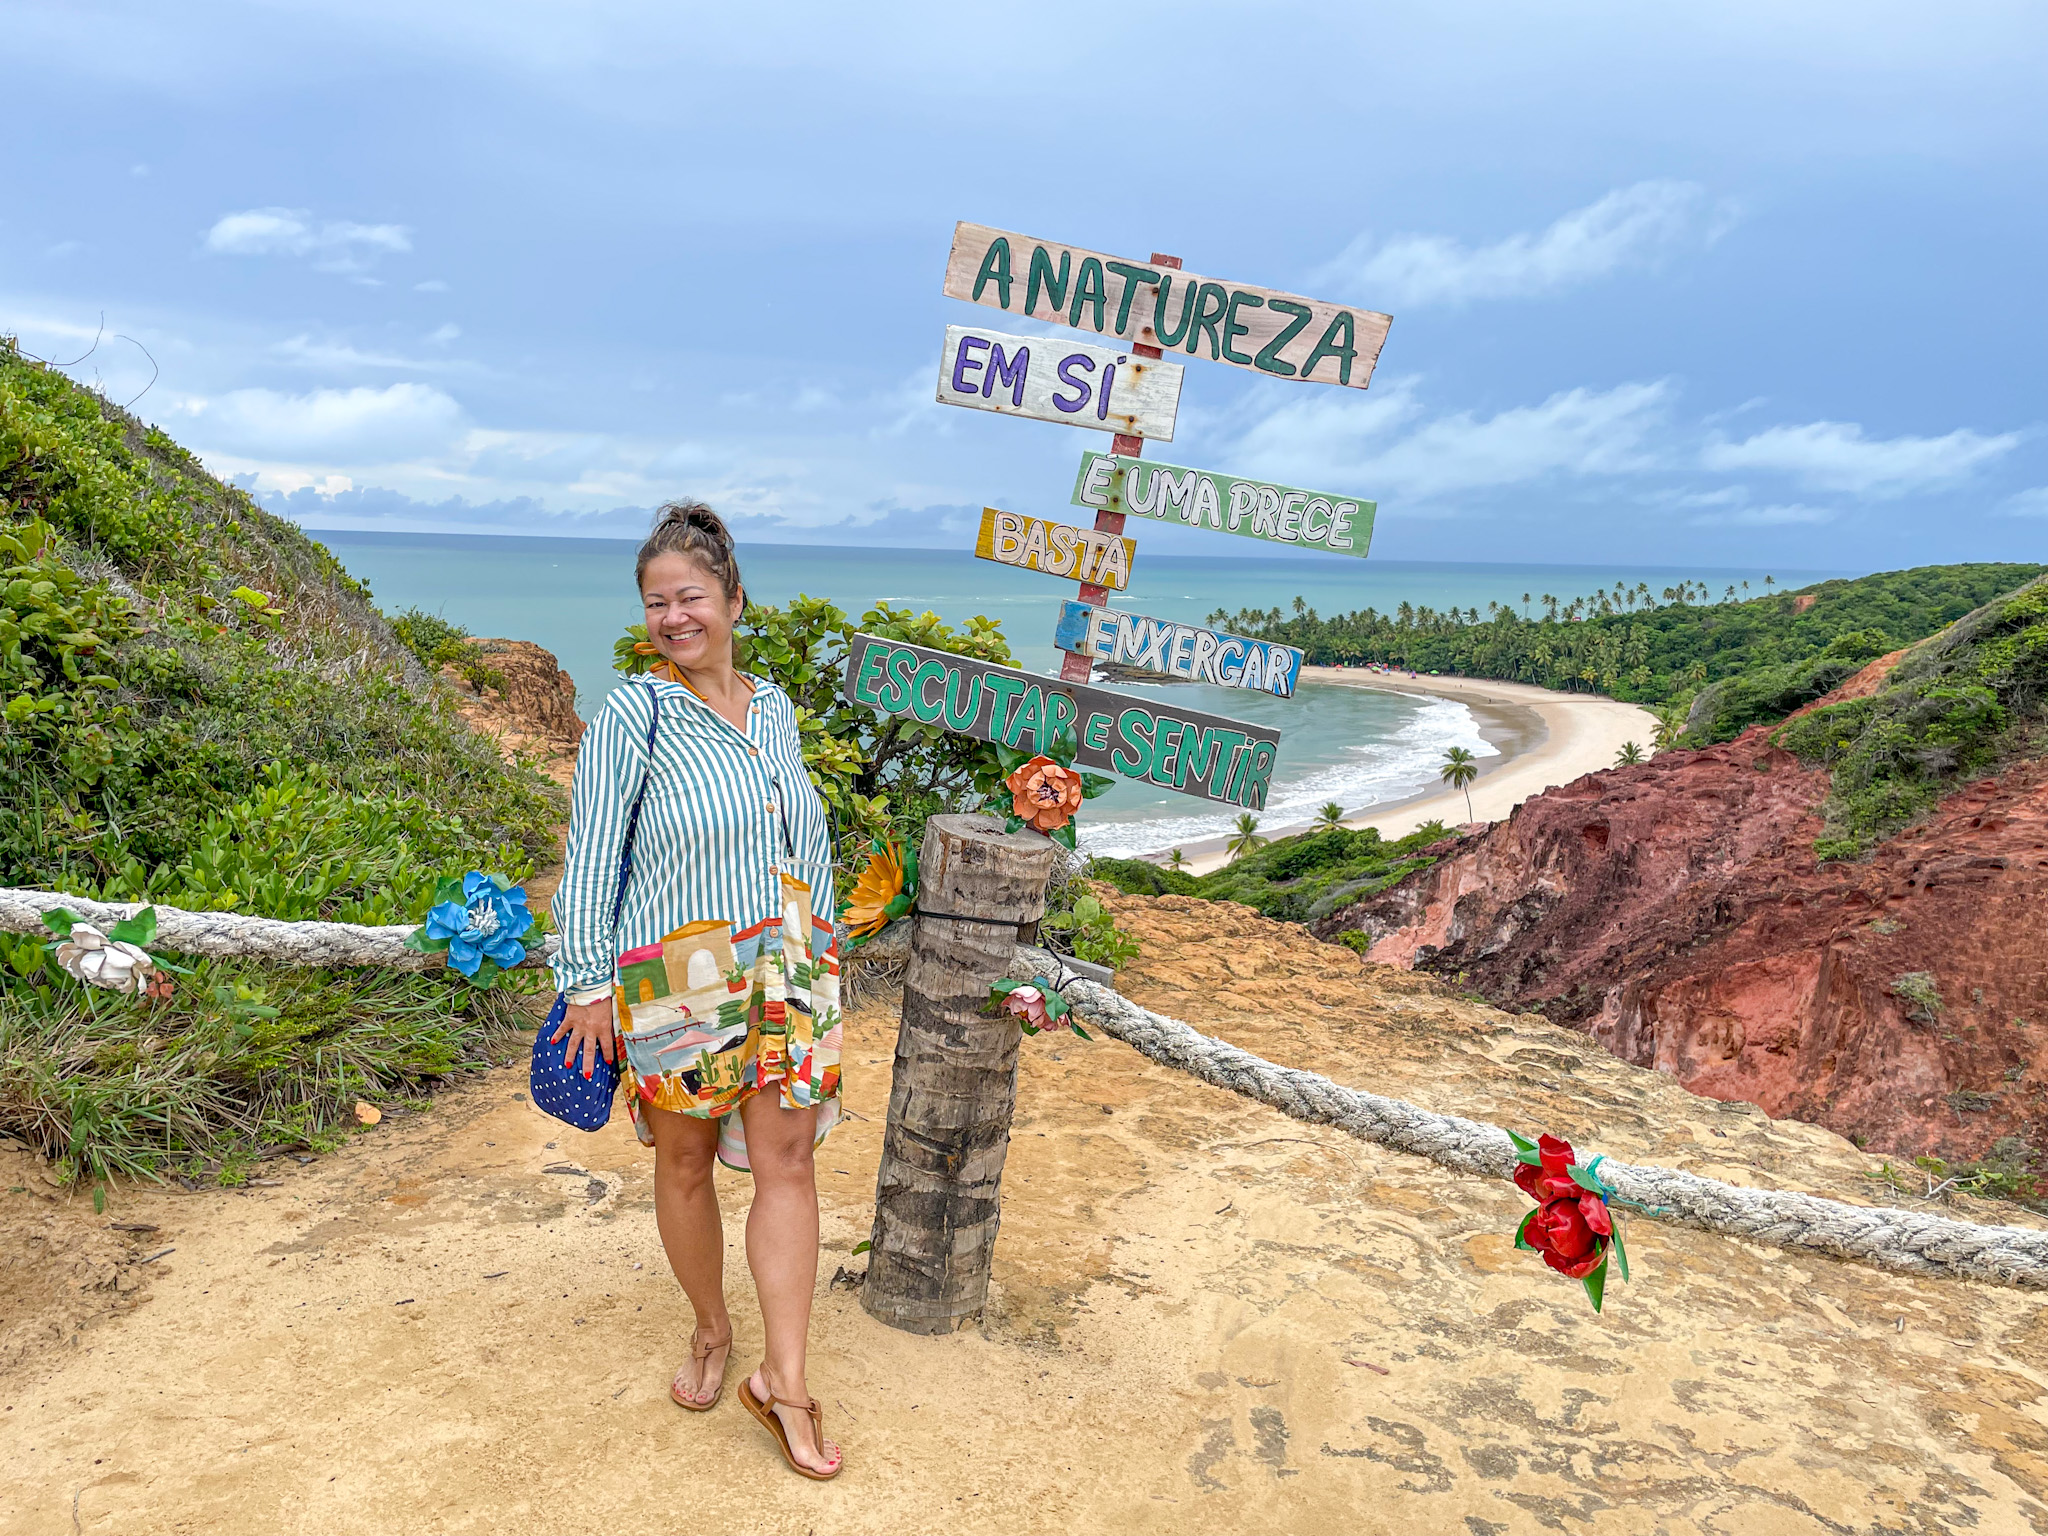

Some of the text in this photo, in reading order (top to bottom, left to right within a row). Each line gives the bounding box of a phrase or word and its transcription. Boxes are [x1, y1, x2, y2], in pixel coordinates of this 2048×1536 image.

[972, 237, 1358, 385] A NATUREZA
[952, 335, 1127, 421] EM SÍ
[1079, 454, 1359, 549] É UMA PRECE
[993, 510, 1129, 590] BASTA
[1087, 607, 1292, 697] ENXERGAR
[854, 641, 1078, 757] ESCUTAR
